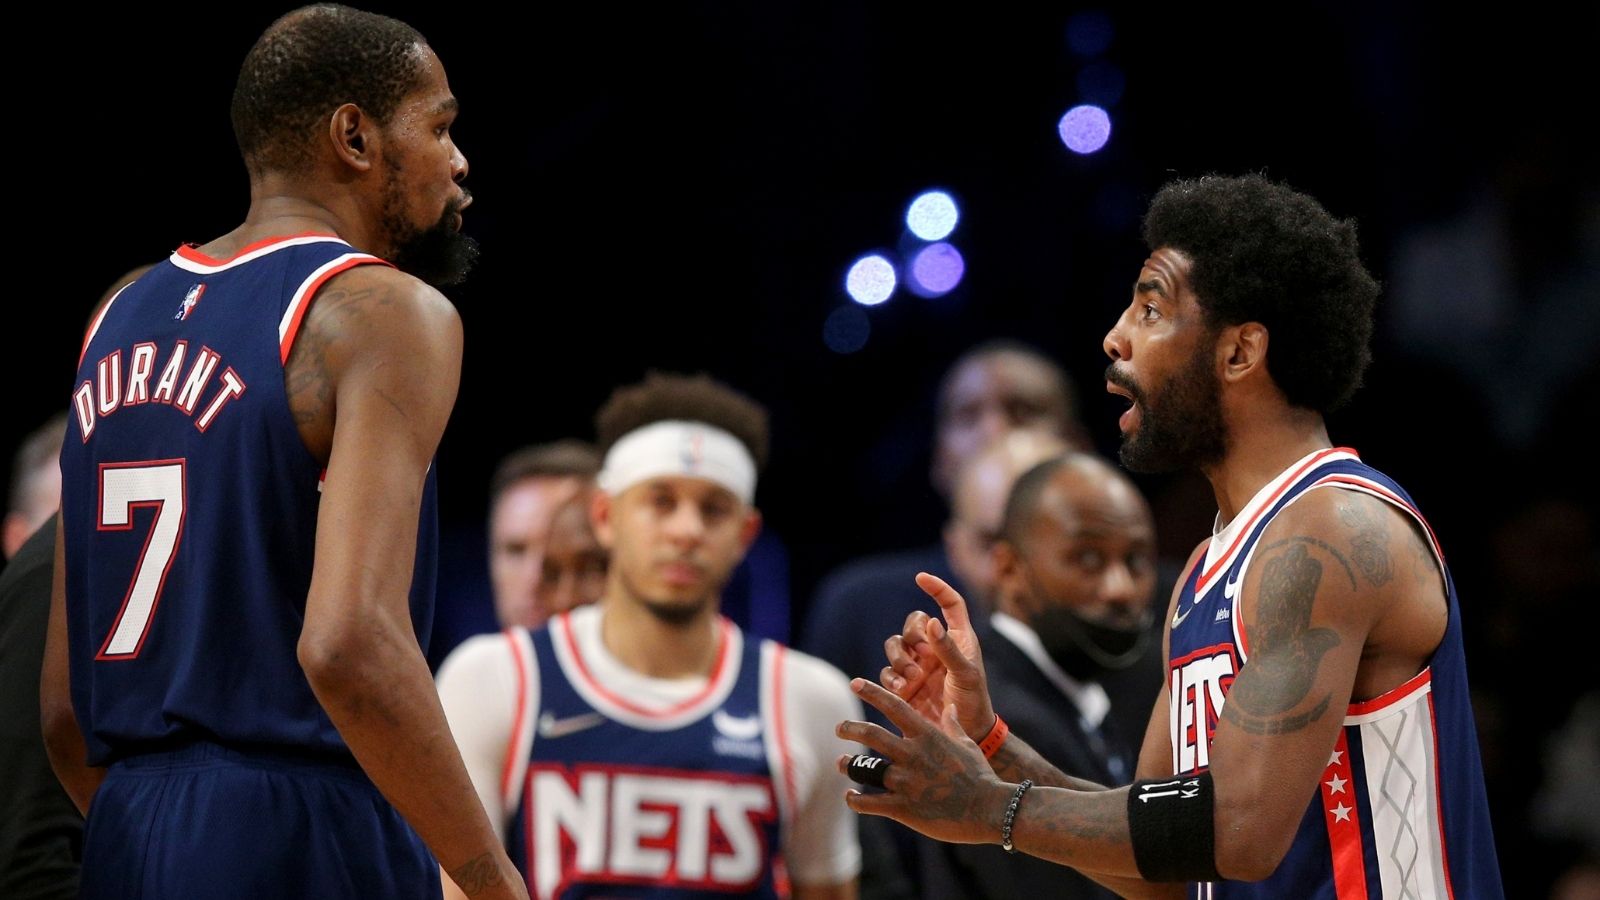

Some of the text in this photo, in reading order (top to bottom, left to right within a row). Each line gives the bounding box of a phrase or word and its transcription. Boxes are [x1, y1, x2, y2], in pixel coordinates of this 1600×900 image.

[73, 340, 246, 443] DURANT
[96, 458, 186, 660] 7
[852, 754, 882, 769] KAI
[1138, 780, 1181, 803] 11
[1181, 778, 1200, 798] KA
[528, 766, 775, 900] NETS
